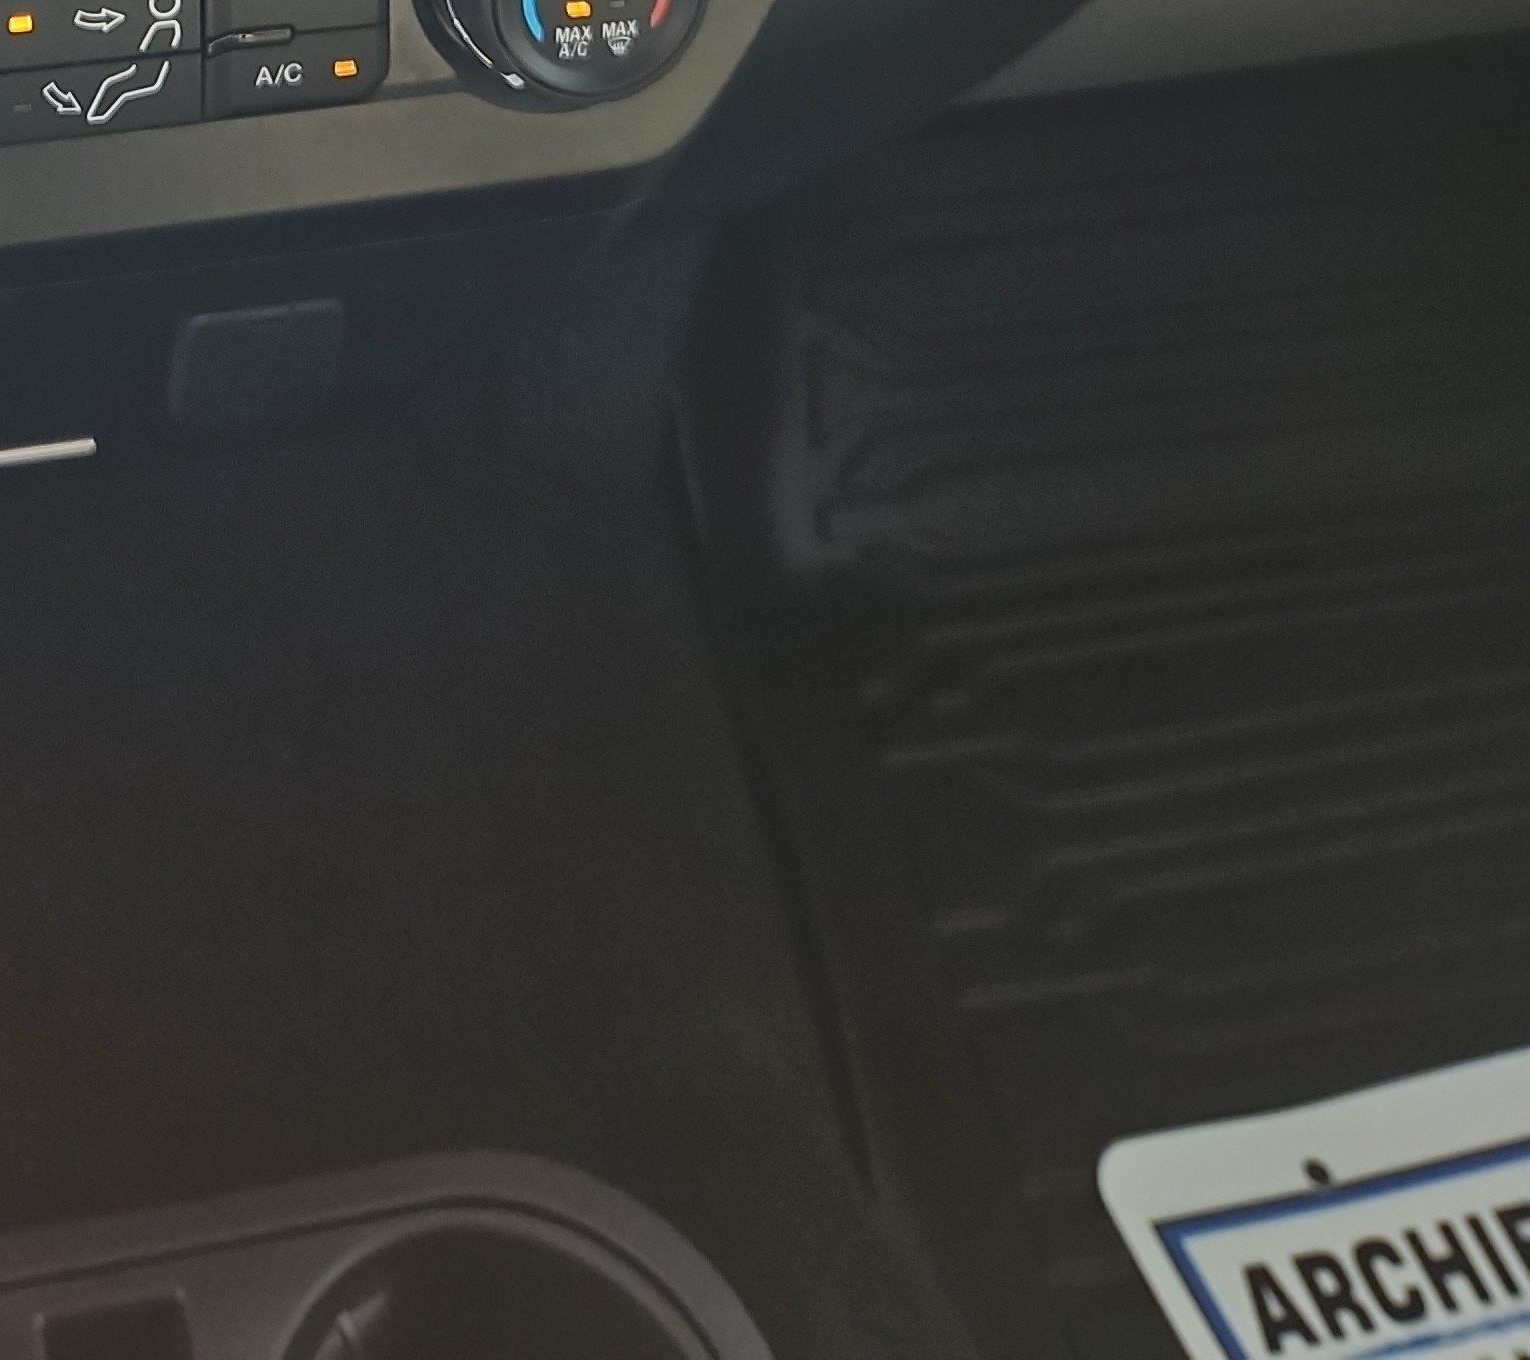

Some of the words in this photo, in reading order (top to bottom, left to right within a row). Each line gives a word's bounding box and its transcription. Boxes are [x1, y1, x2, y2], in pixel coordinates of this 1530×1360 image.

[556, 26, 592, 43] MAX
[602, 19, 638, 38] MAX
[558, 42, 587, 58] A/C
[255, 64, 303, 86] A/C
